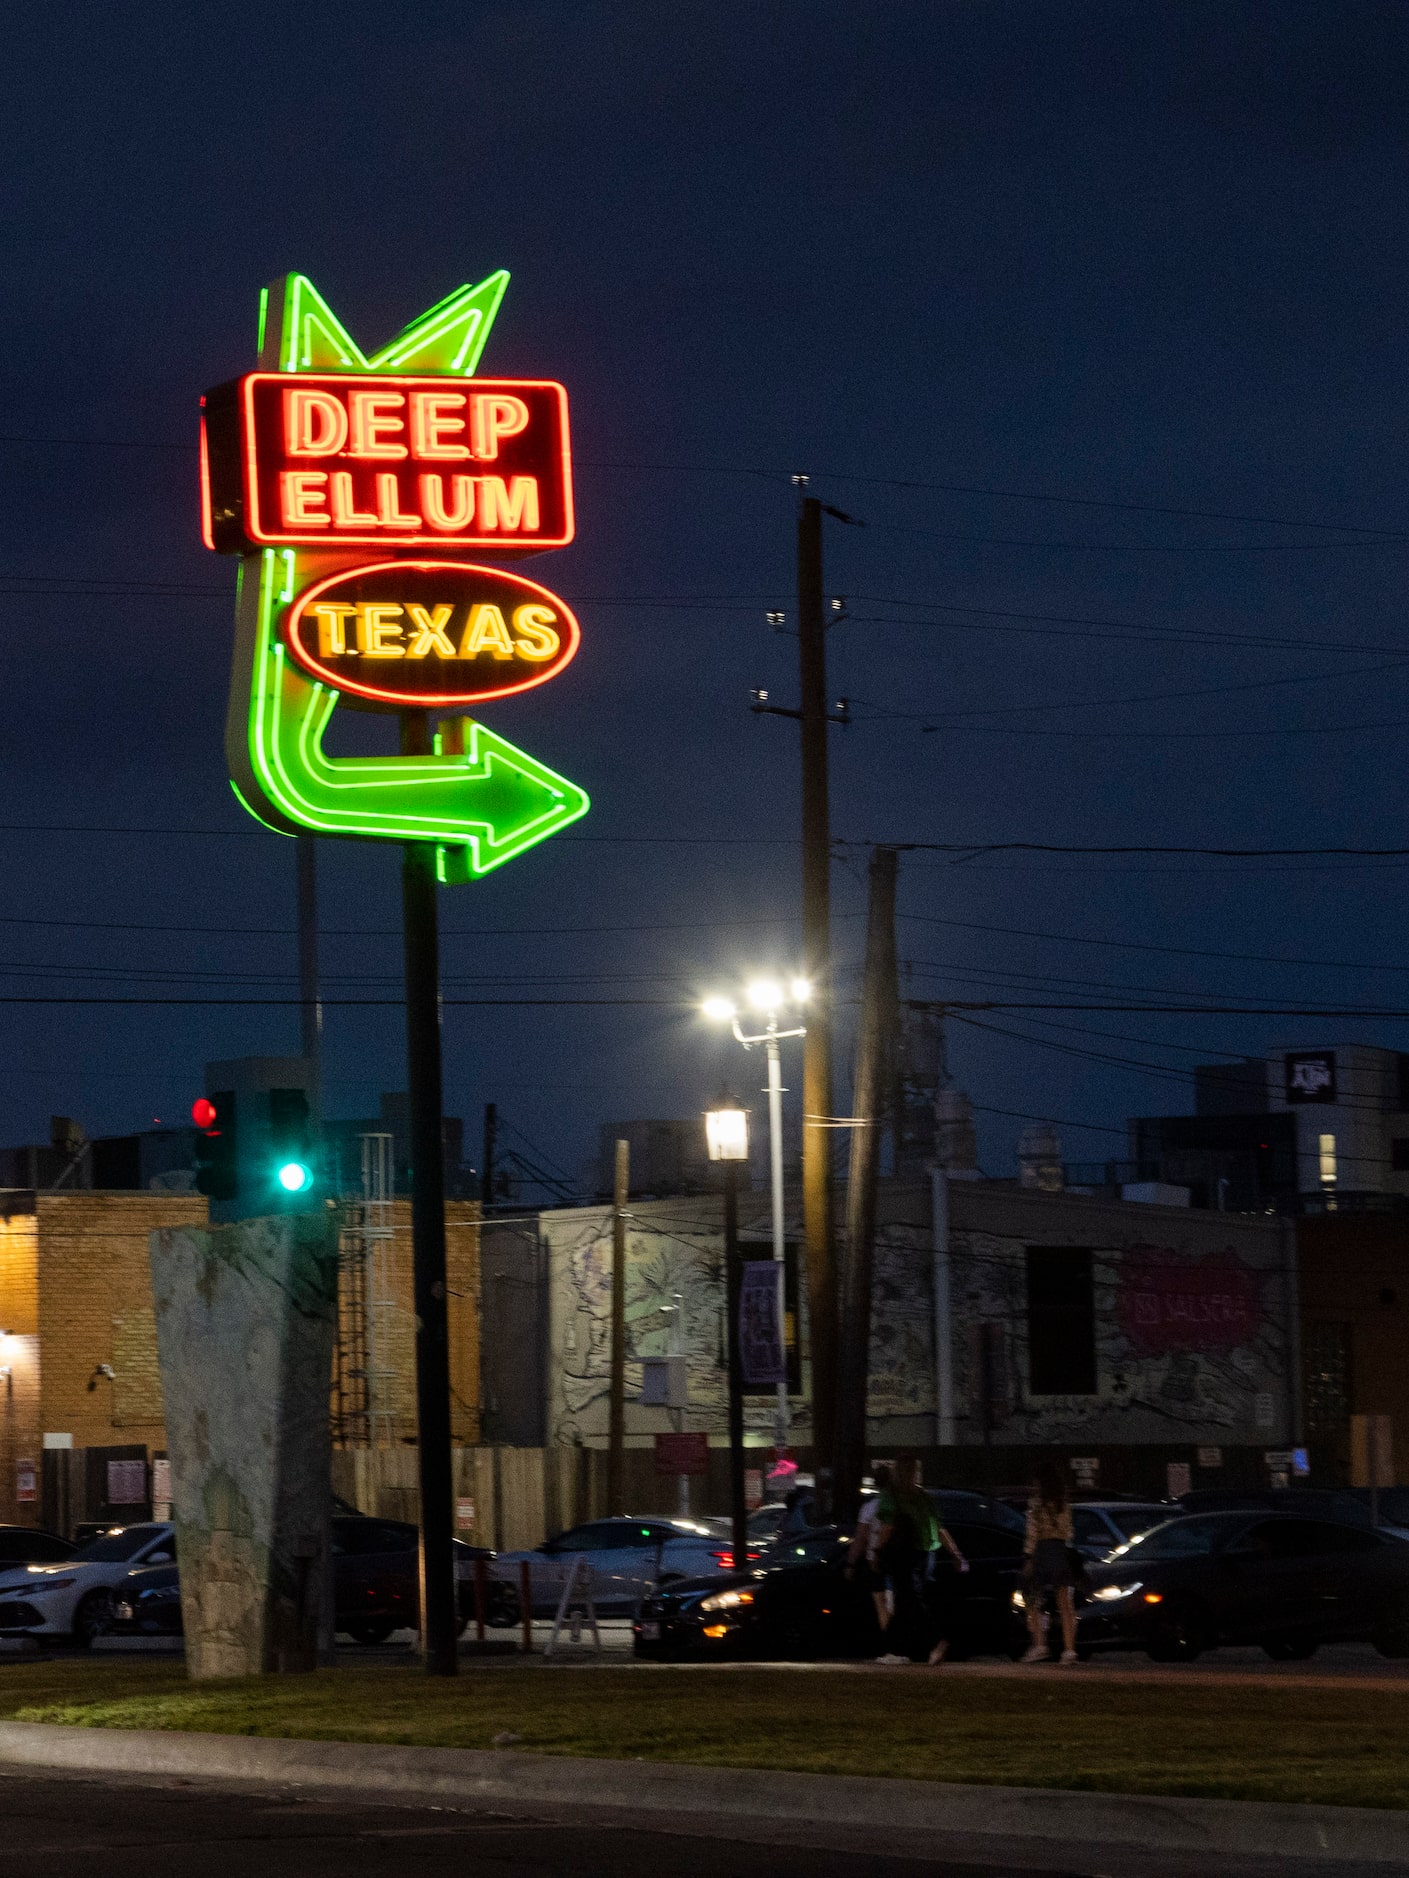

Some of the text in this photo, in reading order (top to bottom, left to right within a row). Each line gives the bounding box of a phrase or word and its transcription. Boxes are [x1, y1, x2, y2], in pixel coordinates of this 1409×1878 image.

[283, 388, 530, 461] DEEP
[280, 471, 542, 531] ELLUM
[306, 601, 561, 662] TEXAS
